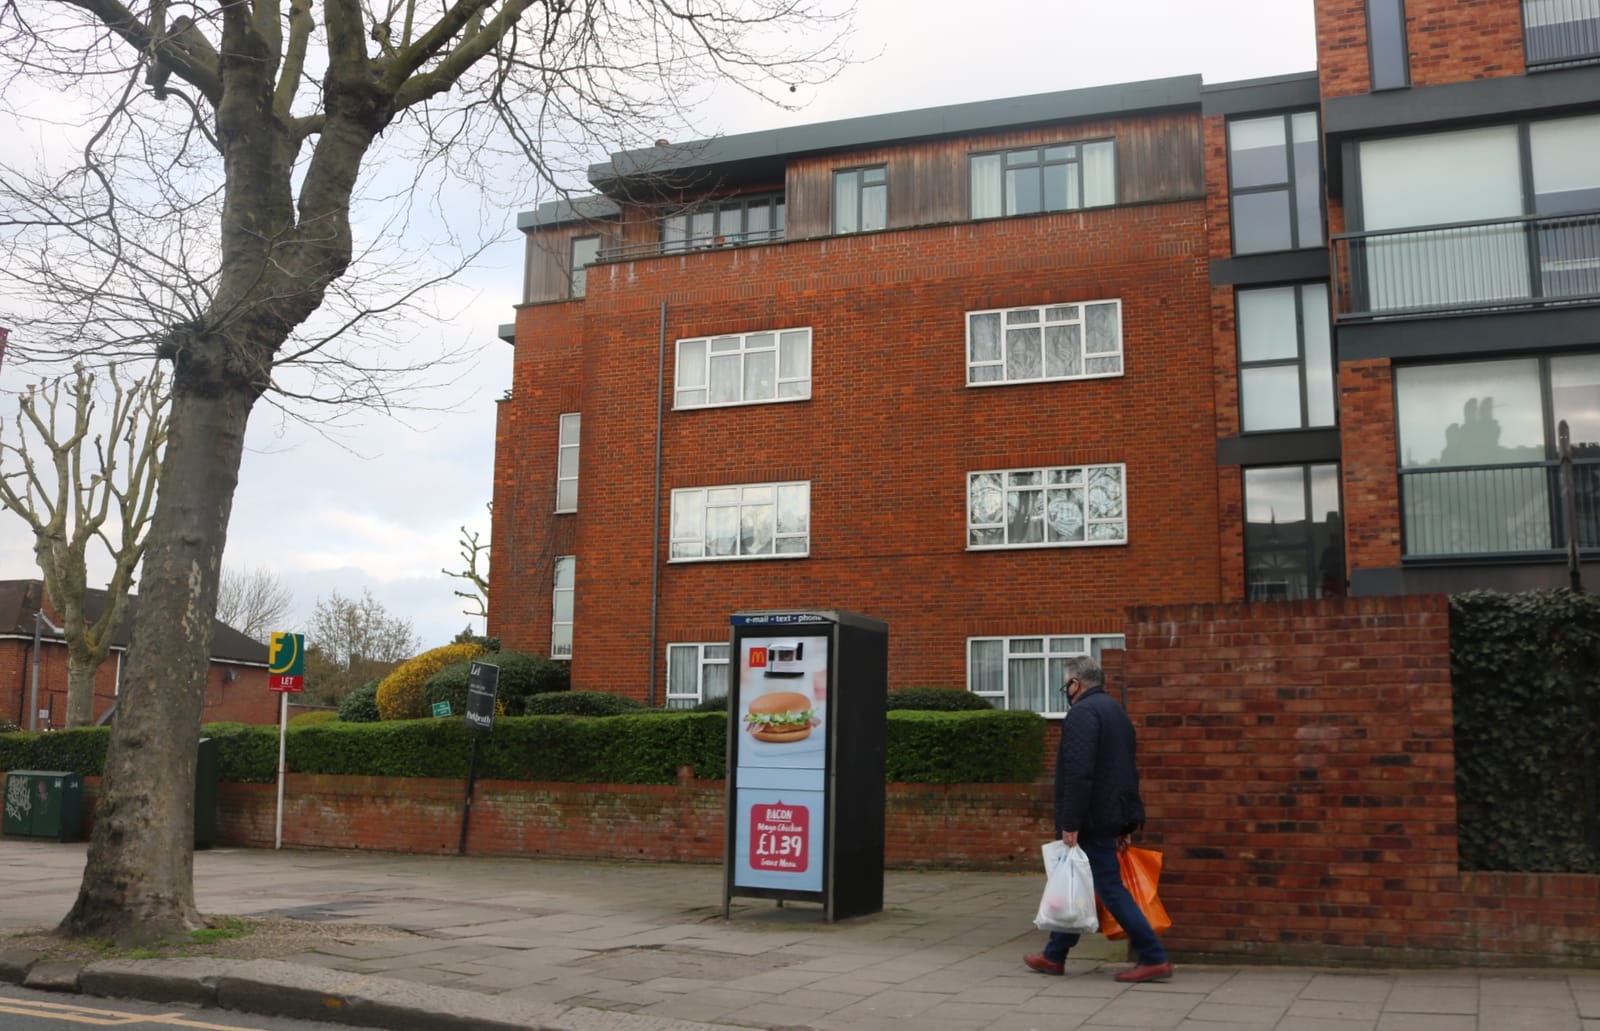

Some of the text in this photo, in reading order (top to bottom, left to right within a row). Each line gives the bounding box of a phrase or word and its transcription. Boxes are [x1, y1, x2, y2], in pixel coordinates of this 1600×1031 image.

[745, 614, 822, 624] e-mail text phone
[281, 676, 294, 685] LET
[766, 808, 793, 820] BACON
[756, 833, 803, 857] £1.39
